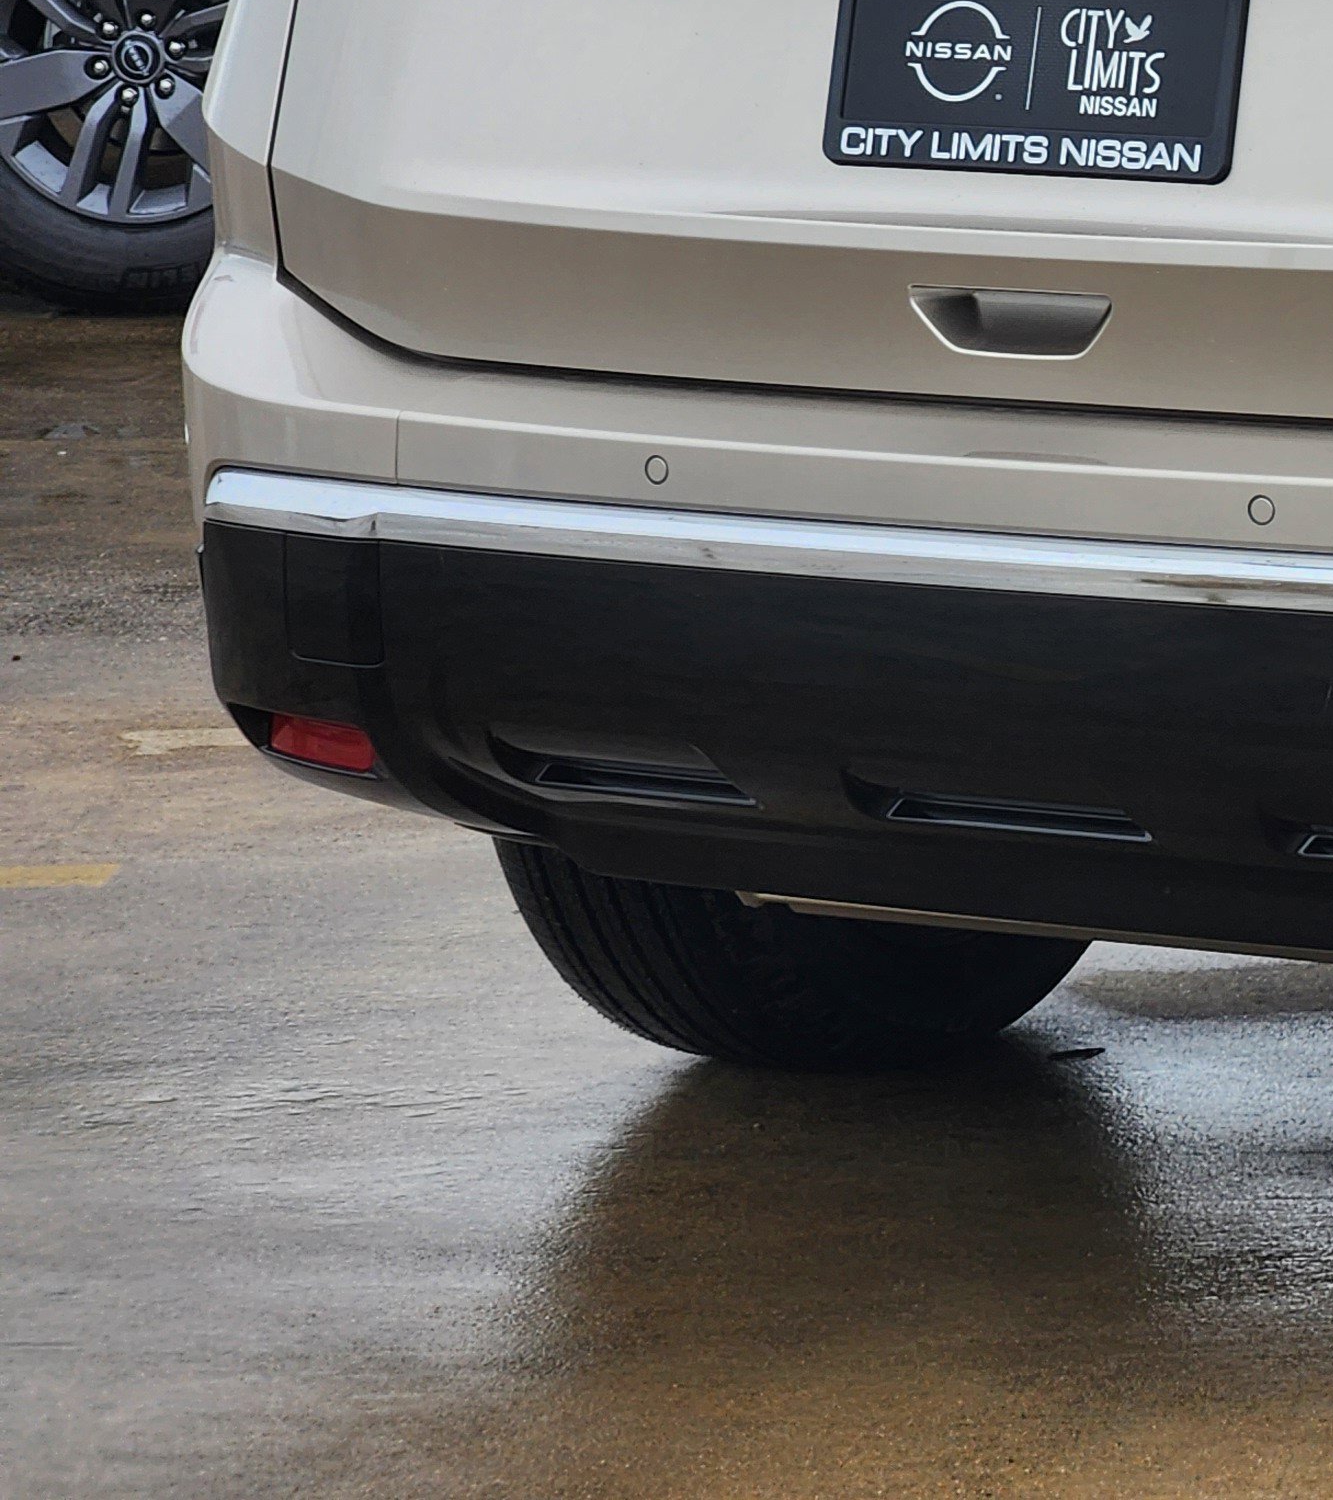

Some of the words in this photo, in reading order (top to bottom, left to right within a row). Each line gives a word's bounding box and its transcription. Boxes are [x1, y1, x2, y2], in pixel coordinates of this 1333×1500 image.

[1060, 8, 1126, 49] CITY
[904, 40, 1013, 62] NISSAN
[1066, 49, 1166, 95] LIMITS
[1079, 95, 1158, 118] NISSAN
[839, 125, 924, 158] CITY
[930, 130, 1049, 165] LIMITS
[1059, 137, 1202, 173] NISSAN
